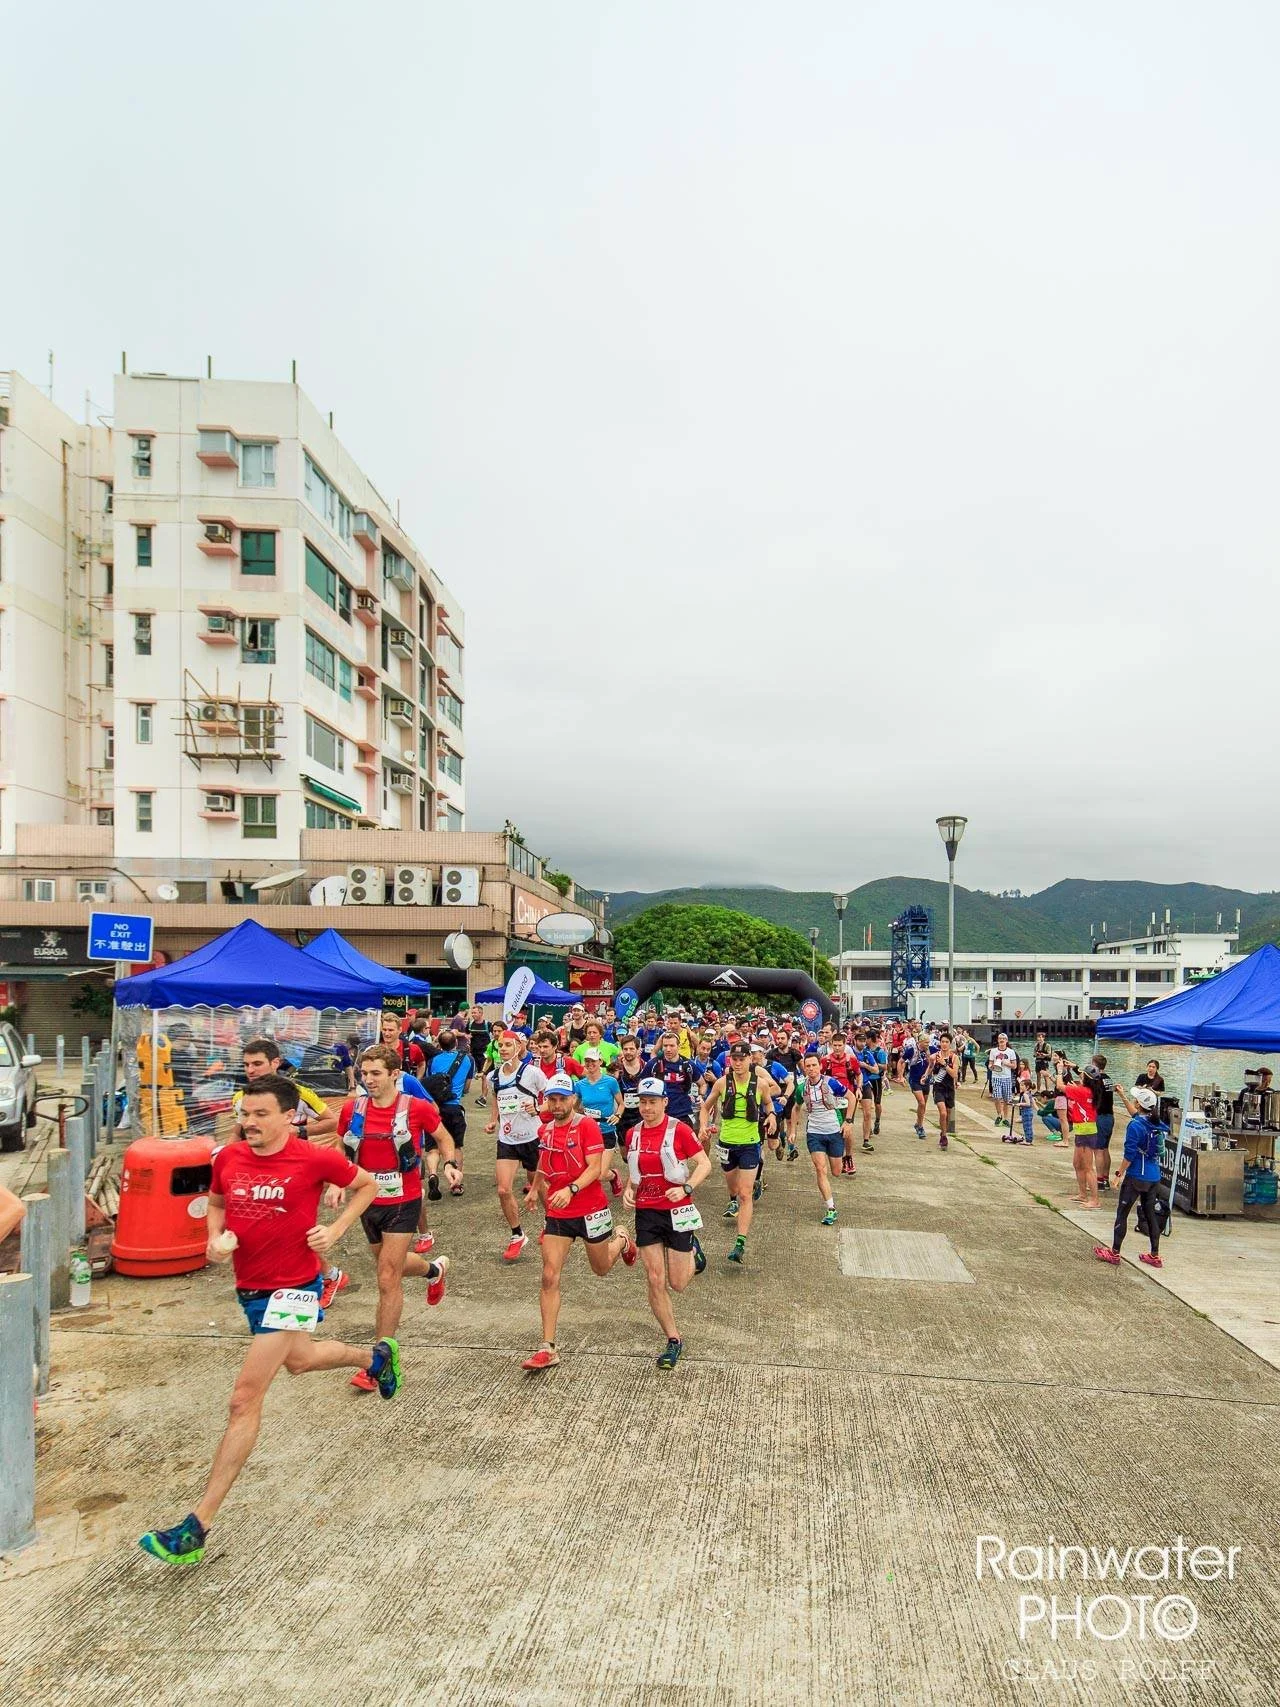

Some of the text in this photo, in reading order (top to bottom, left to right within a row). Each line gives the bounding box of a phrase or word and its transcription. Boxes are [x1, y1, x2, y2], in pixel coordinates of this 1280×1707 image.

[113, 923, 129, 931] NO
[110, 930, 132, 939] EXIT
[94, 939, 146, 952] 不准駛出
[33, 947, 68, 956] EURASIA
[511, 974, 528, 1011] tailwind
